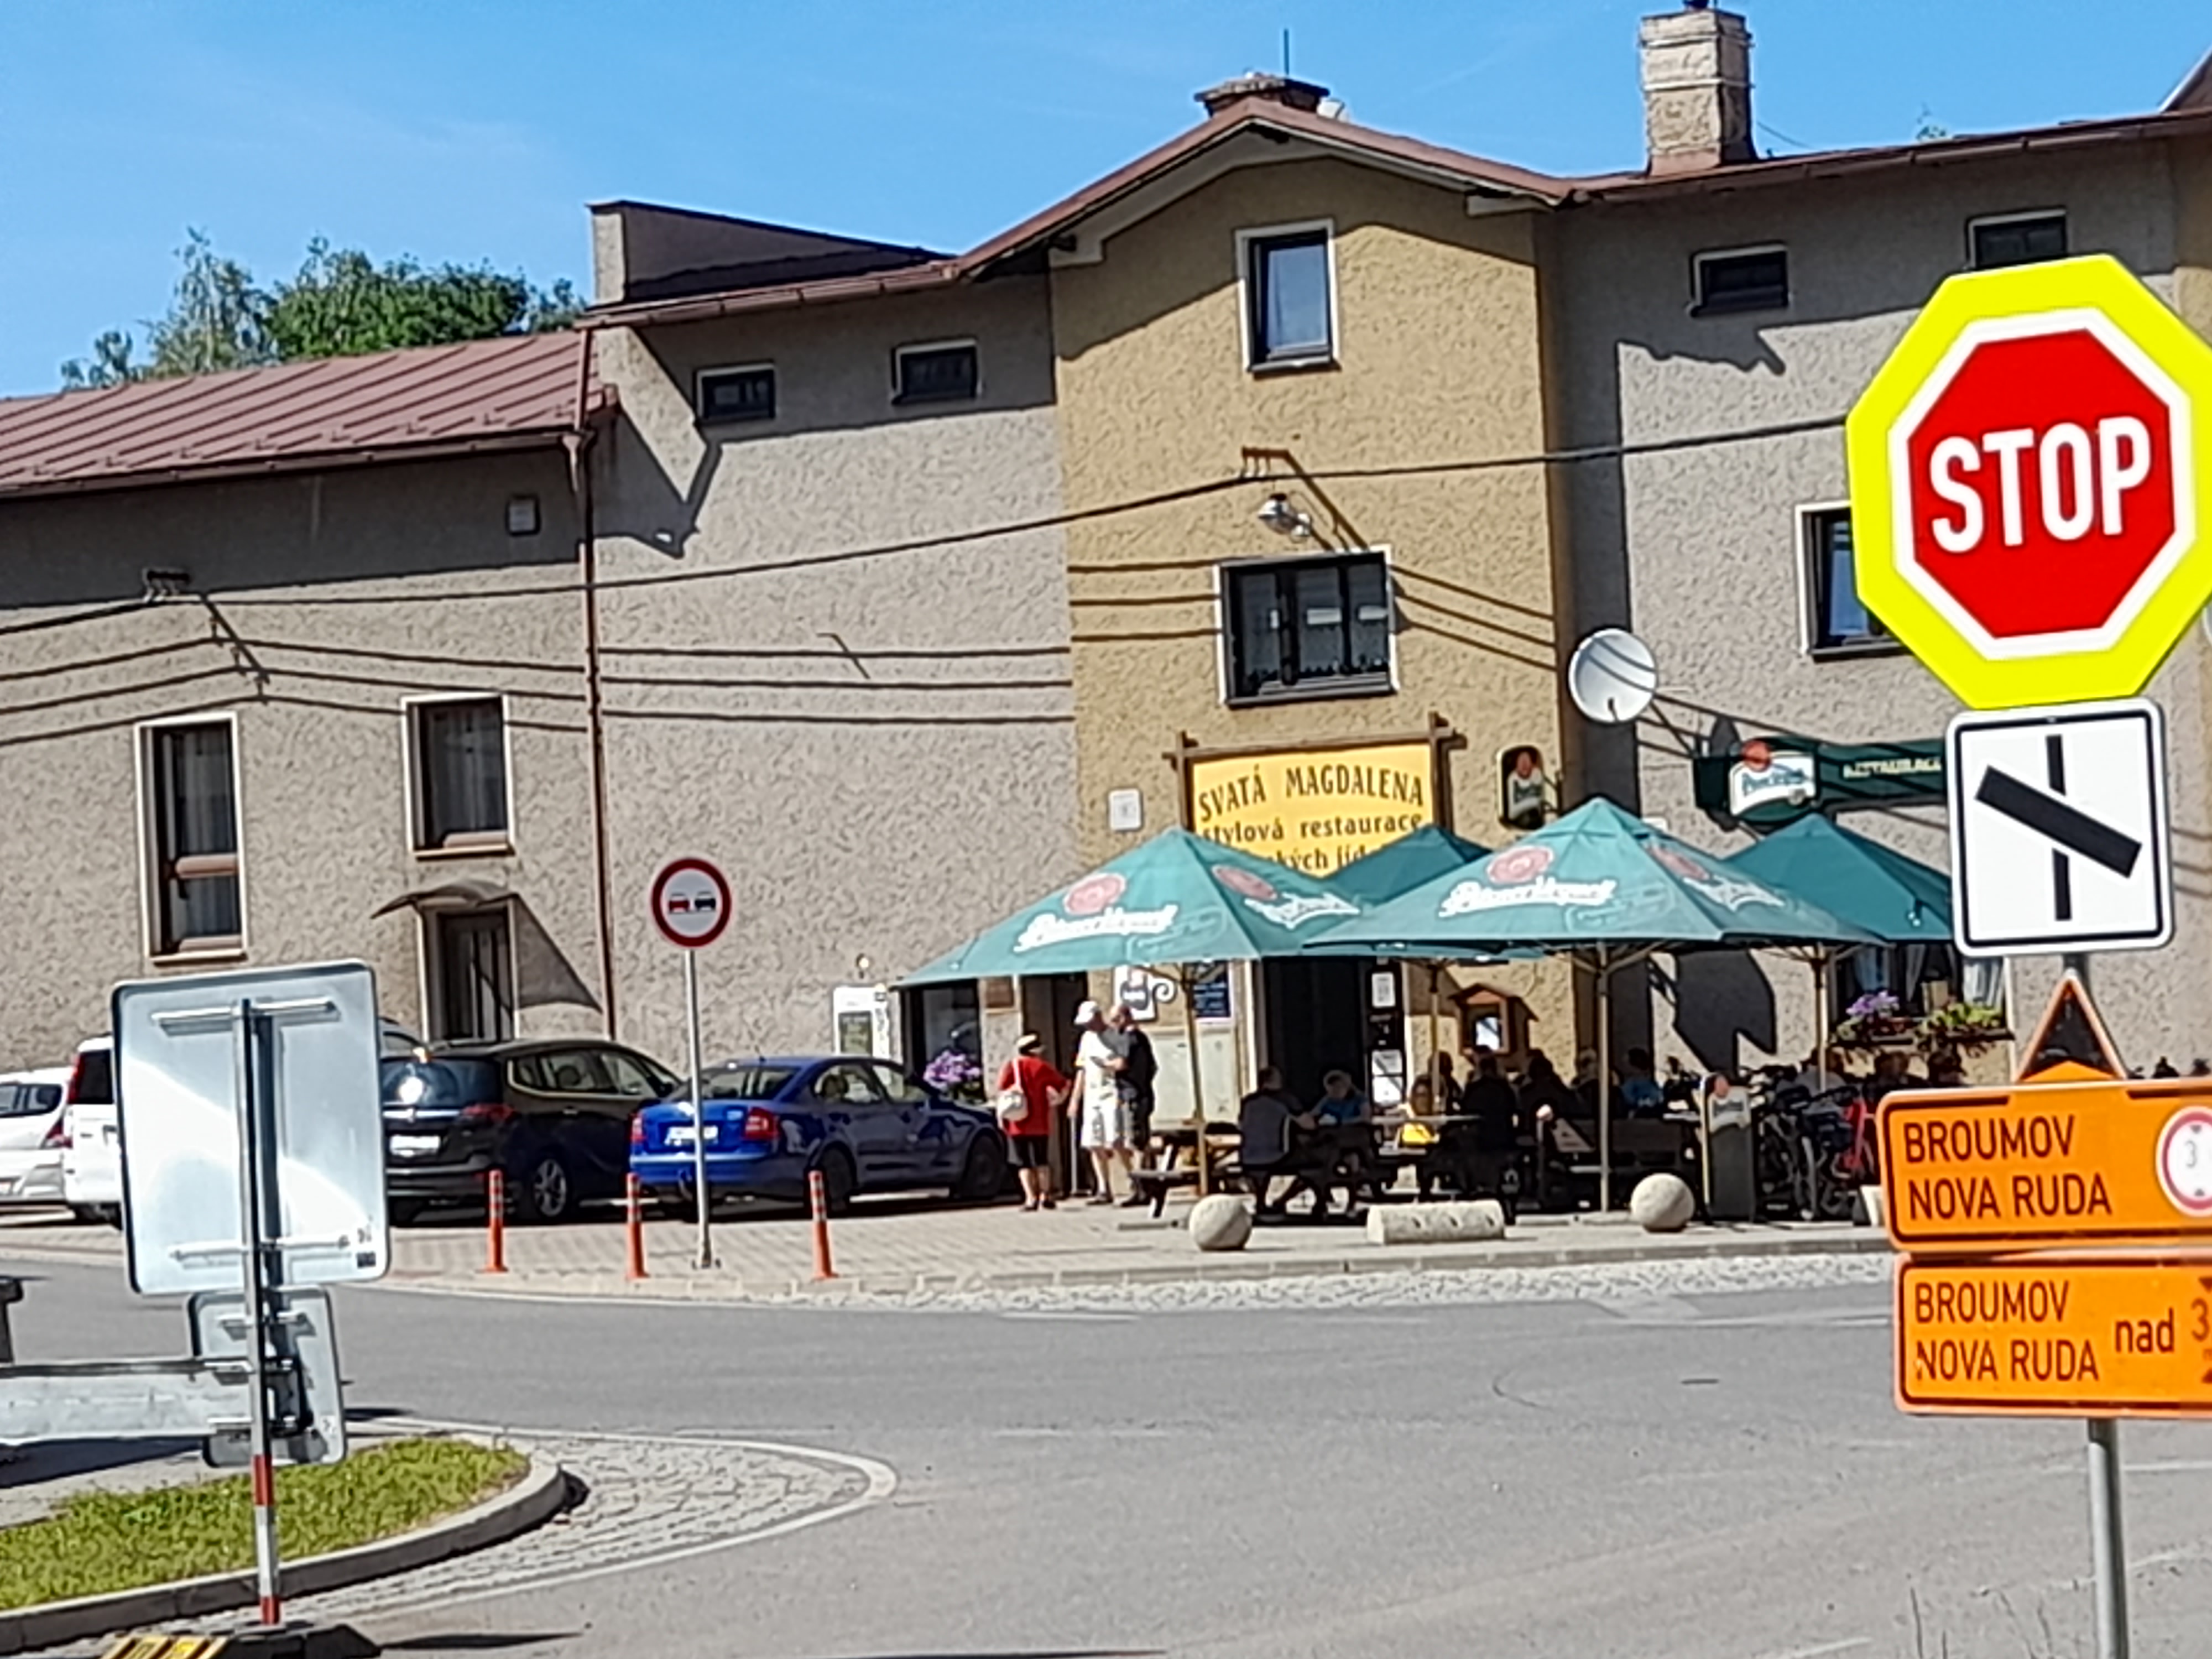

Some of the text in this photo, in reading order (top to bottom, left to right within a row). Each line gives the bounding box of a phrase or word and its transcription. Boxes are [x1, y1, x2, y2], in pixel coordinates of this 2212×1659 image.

[1929, 416, 2152, 554] STOP
[1198, 764, 1424, 822] SVATÁ MAGDALENA
[1300, 813, 1422, 839] restaurace
[1903, 1115, 2075, 1164] BROUMOV
[1908, 1172, 2112, 1220] NOVA RUDA
[1914, 1280, 2070, 1323] BROUMOV
[2115, 1307, 2174, 1353] nad
[1916, 1339, 2099, 1381] NOVA RUDA
